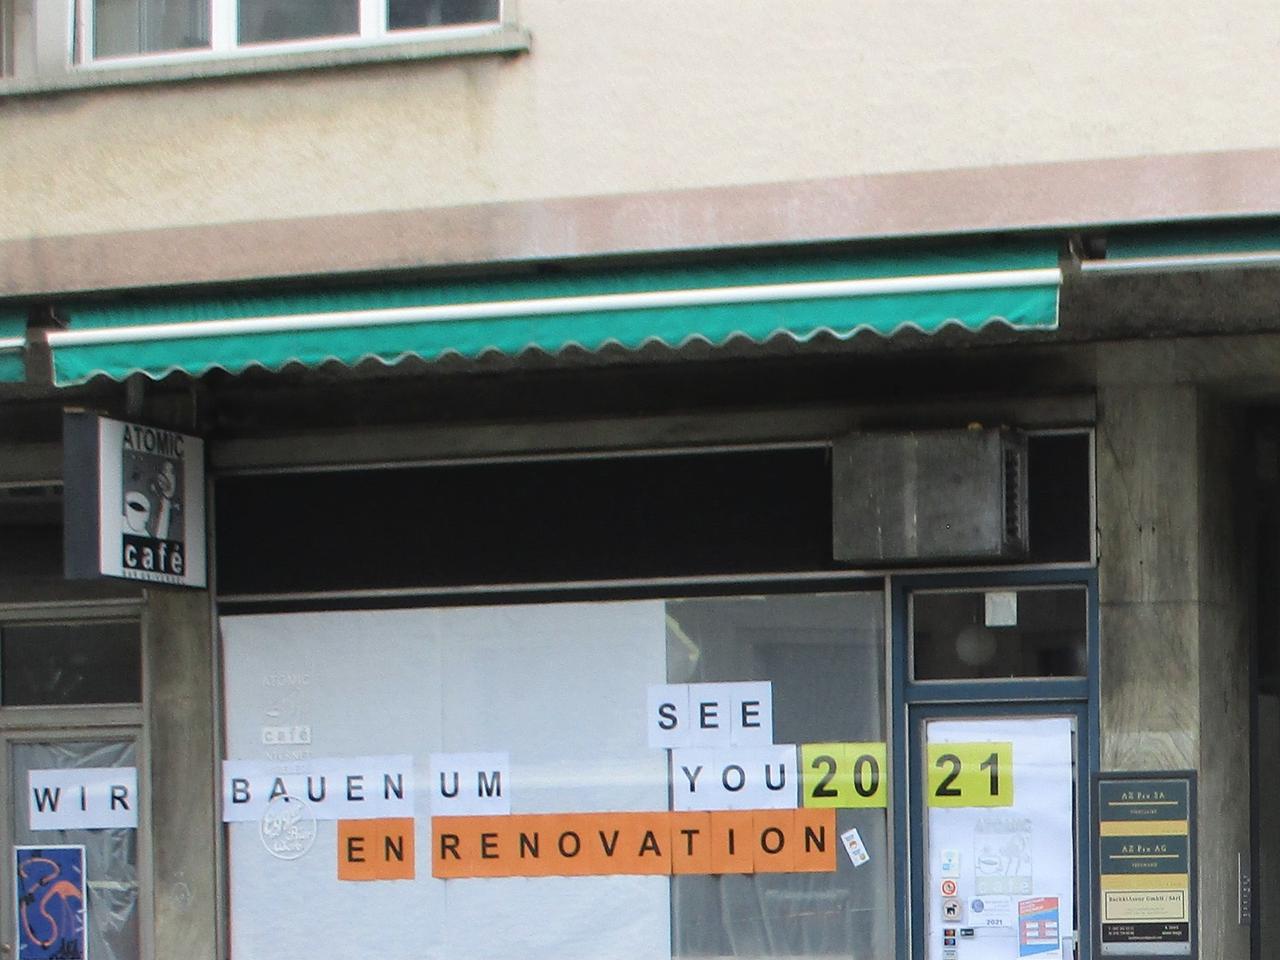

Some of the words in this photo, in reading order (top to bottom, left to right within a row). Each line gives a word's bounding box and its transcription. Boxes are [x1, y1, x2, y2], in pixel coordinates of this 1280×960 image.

[124, 425, 185, 457] ATOMIC
[125, 541, 184, 575] café
[657, 700, 761, 730] SEE
[34, 785, 130, 812] WIR
[232, 774, 404, 804] BAUEN
[440, 771, 501, 798] UM
[681, 764, 787, 793] YOU
[347, 836, 404, 863] EN
[440, 826, 827, 860] RENOVATION
